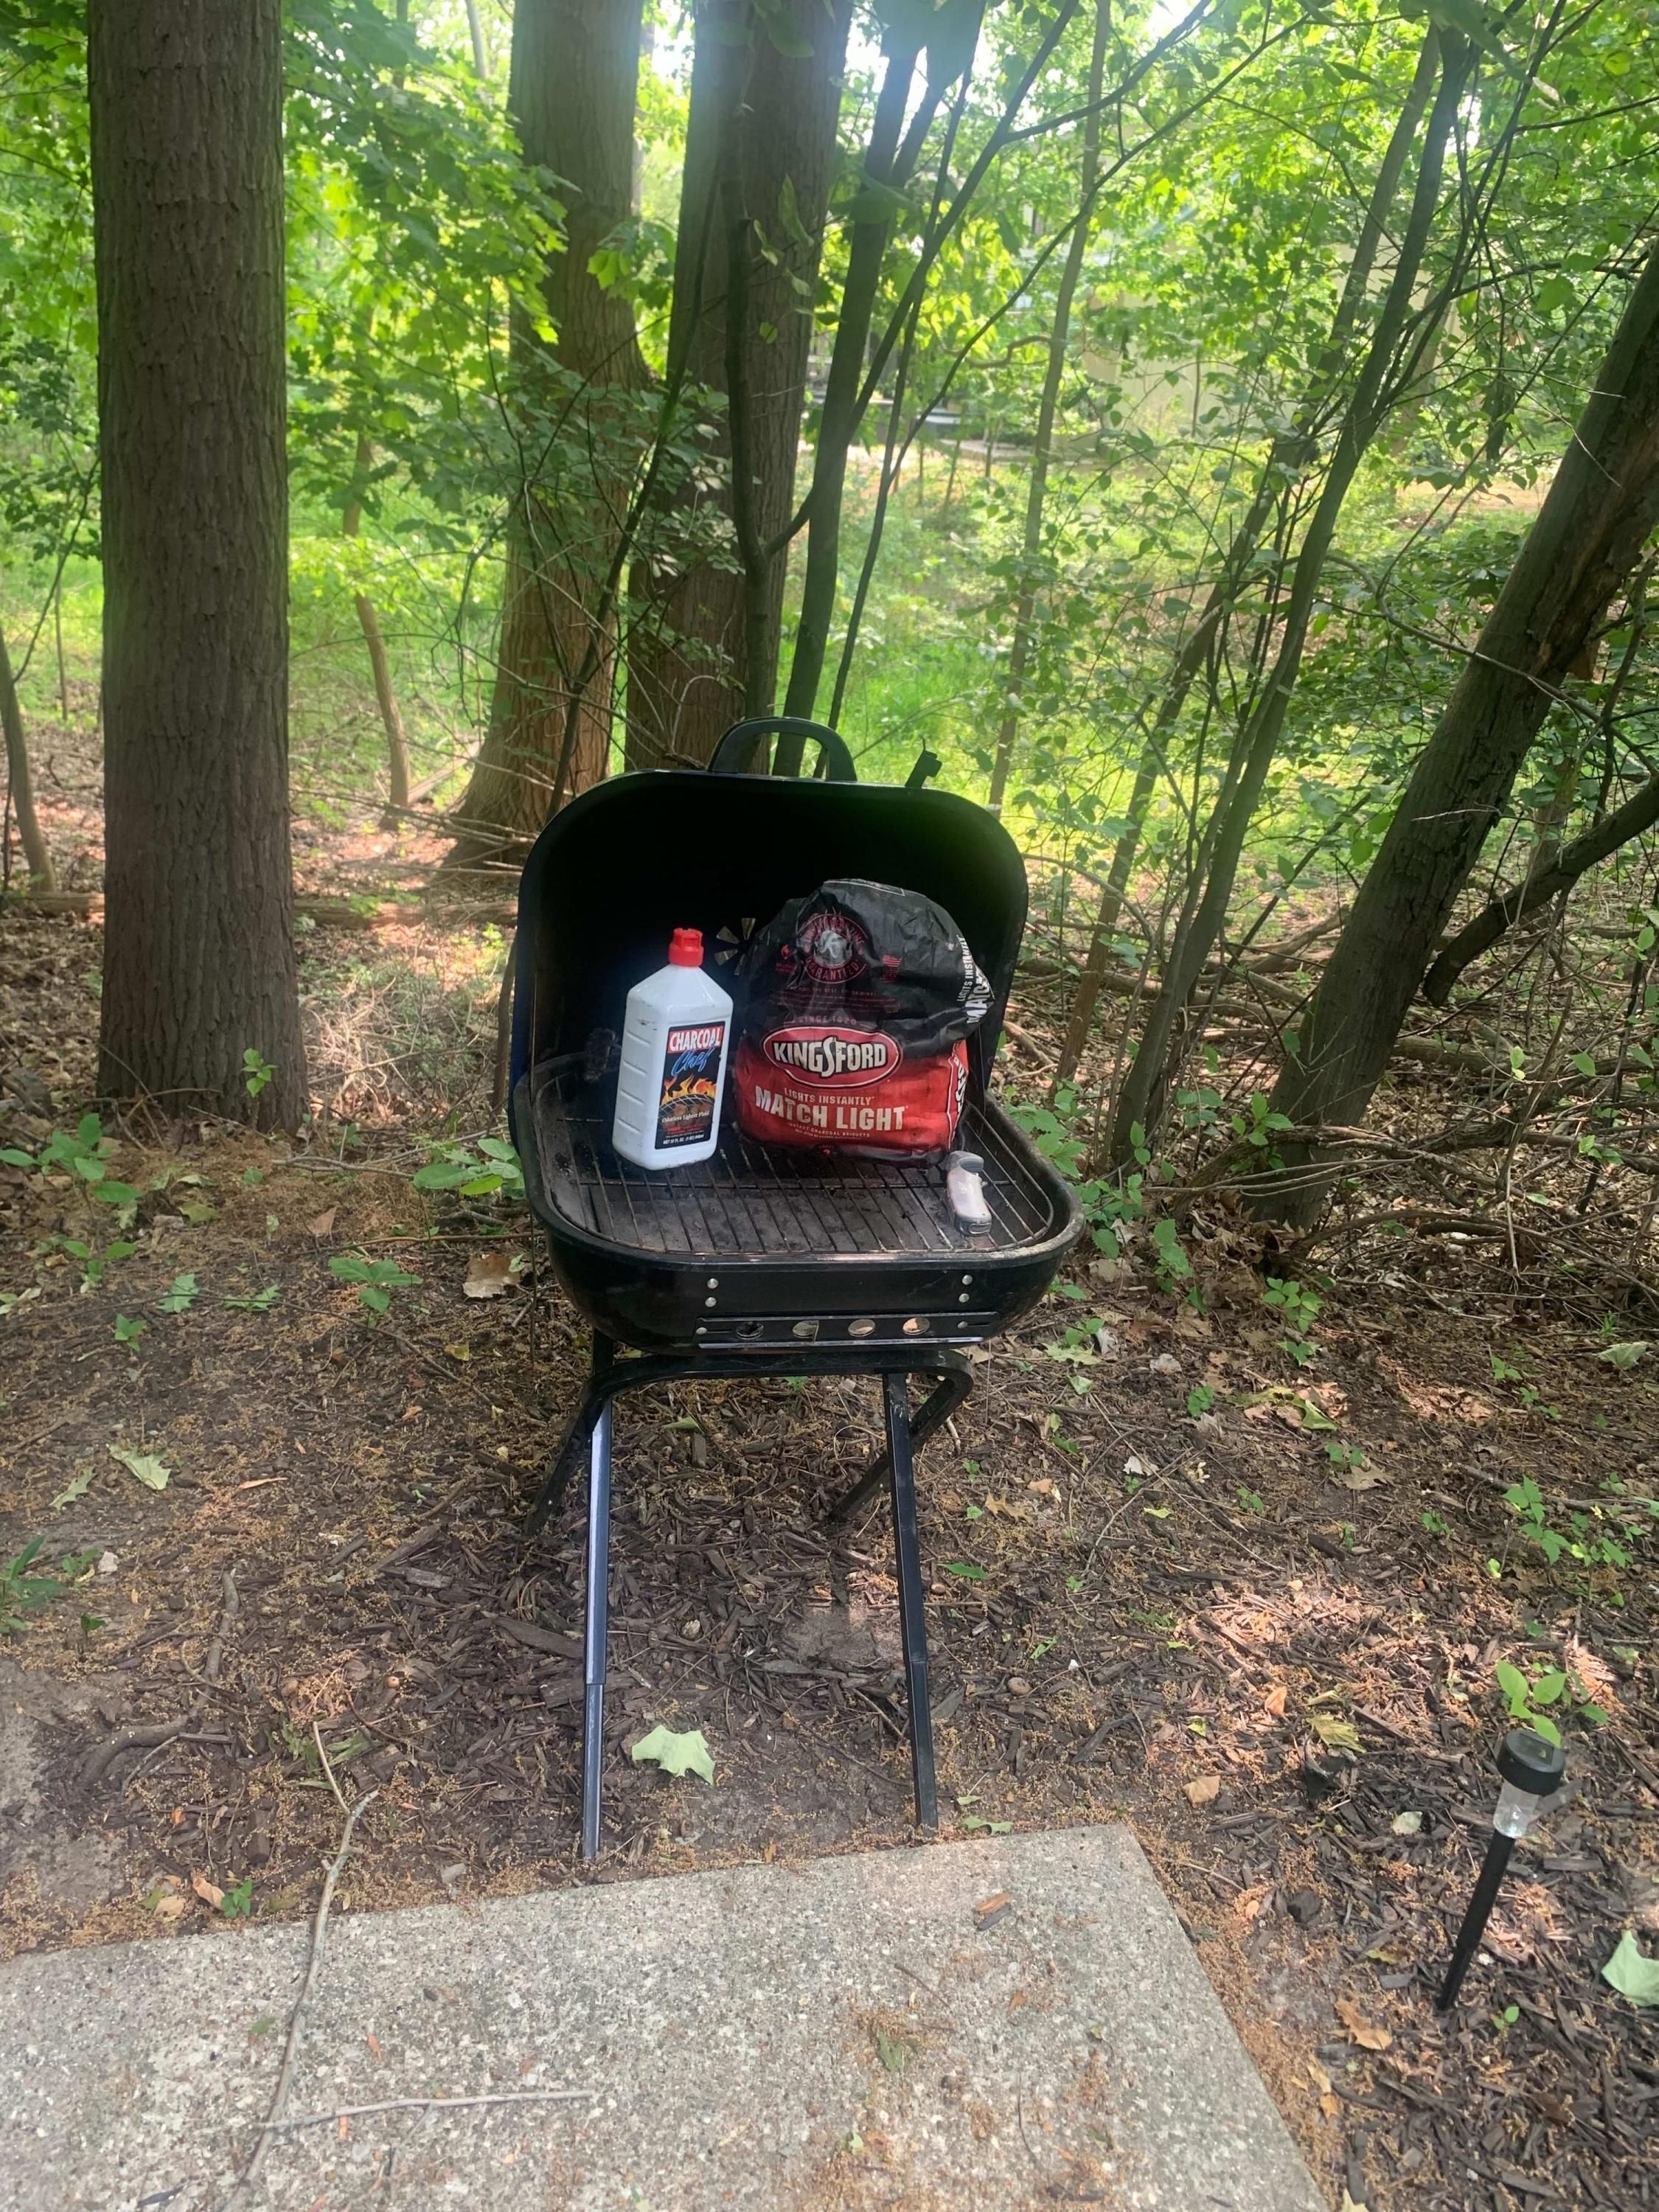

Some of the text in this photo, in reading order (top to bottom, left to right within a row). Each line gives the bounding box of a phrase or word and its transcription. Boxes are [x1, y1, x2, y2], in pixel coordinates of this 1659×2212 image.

[798, 1015, 828, 1023] SINCE
[669, 1027, 721, 1051] CHARCOAL
[671, 1045, 715, 1077] Chef
[773, 1037, 886, 1077] KINGSFORD
[755, 1085, 827, 1128] MATCH
[784, 1087, 815, 1102] LIGHTS
